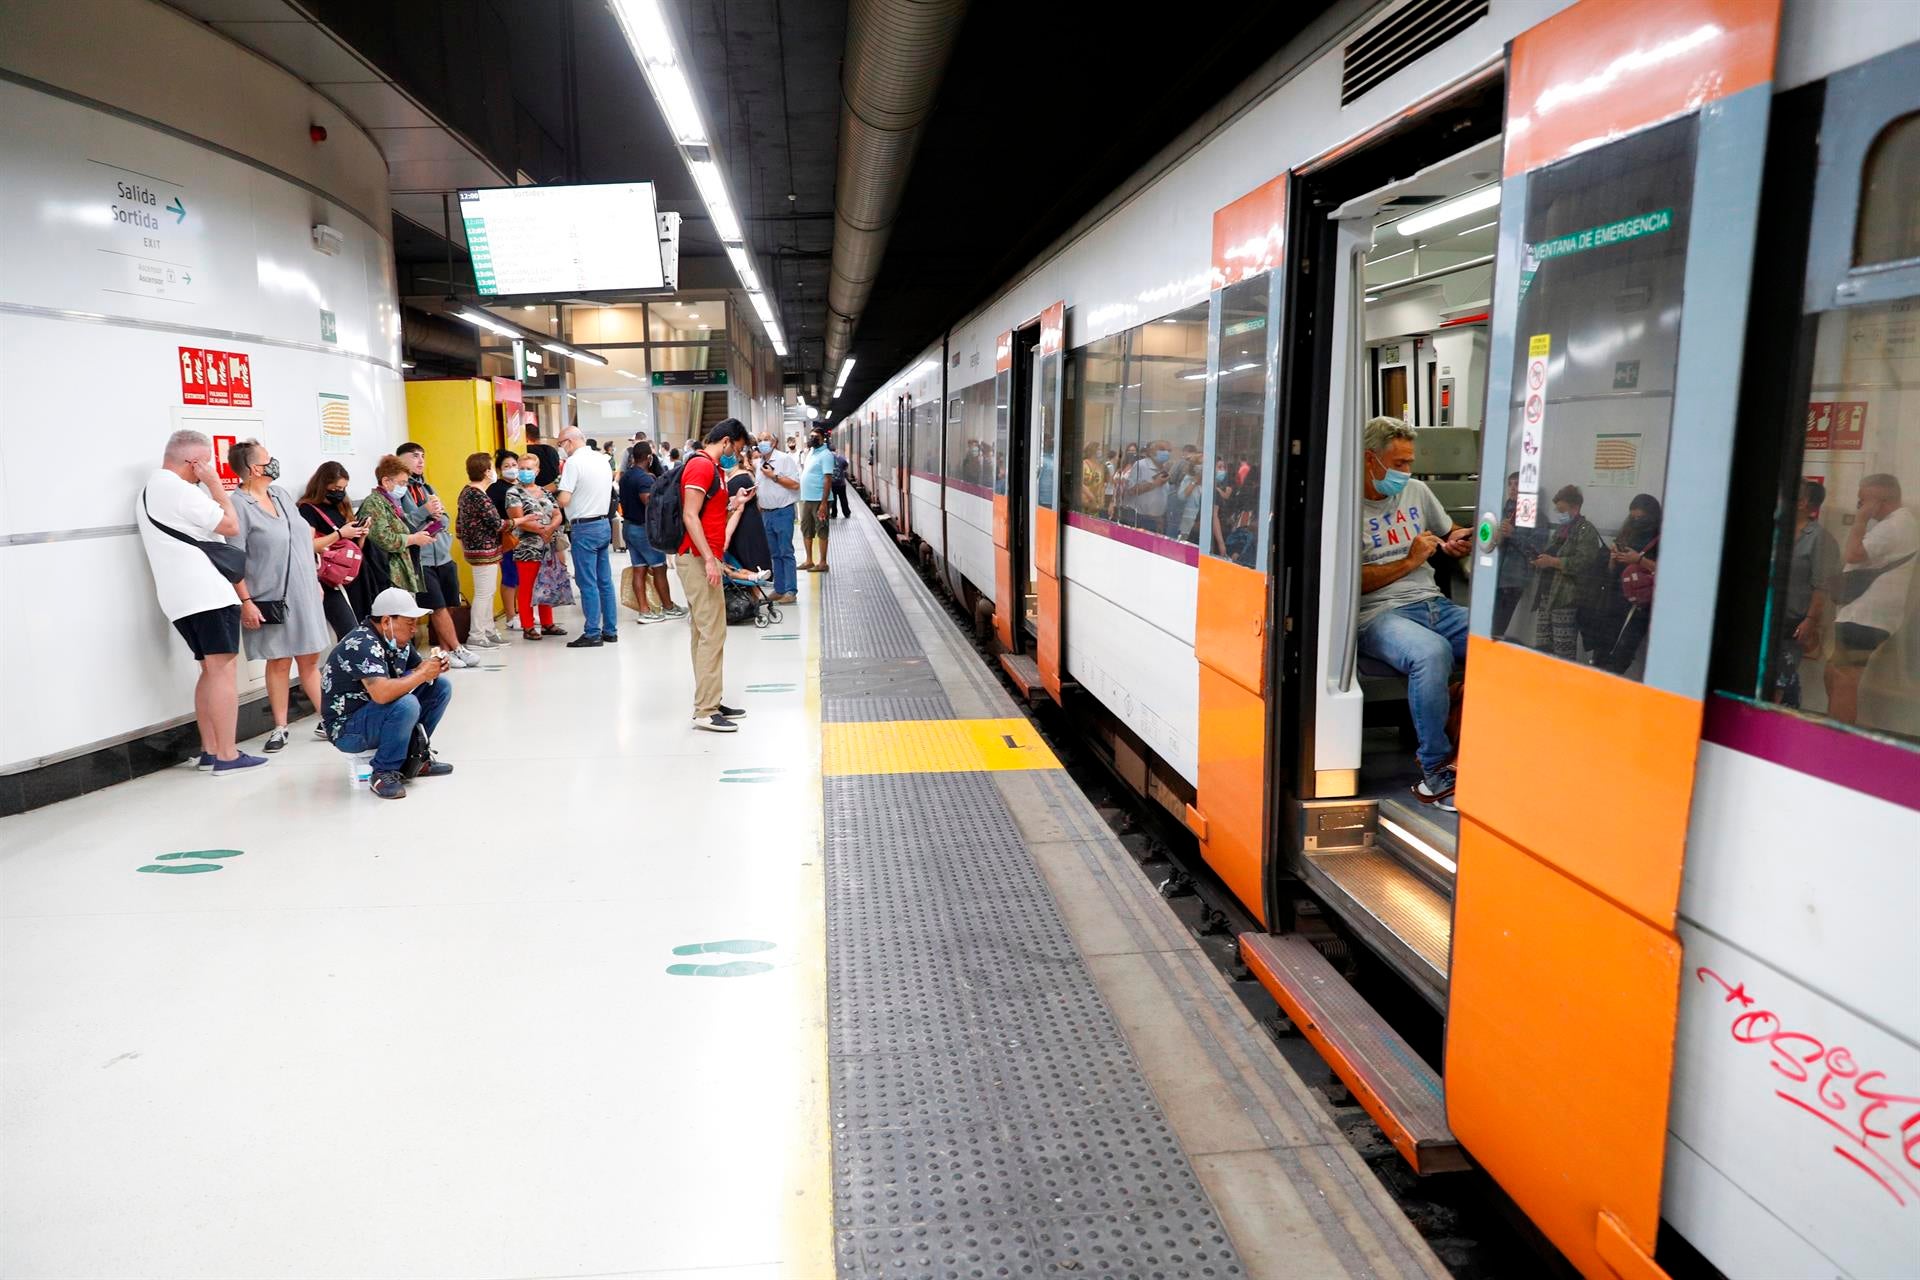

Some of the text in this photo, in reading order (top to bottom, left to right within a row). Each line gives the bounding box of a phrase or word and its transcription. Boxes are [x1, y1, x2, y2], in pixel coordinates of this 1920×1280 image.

[117, 181, 157, 206] Salida
[460, 192, 479, 200] 12:00
[111, 205, 159, 230] Sortida
[143, 237, 161, 249] EXIT
[1534, 238, 1576, 259] VENTANA
[1578, 232, 1592, 249] DE
[1594, 212, 1668, 245] EMERGENCIA
[1369, 506, 1420, 531] STAR
